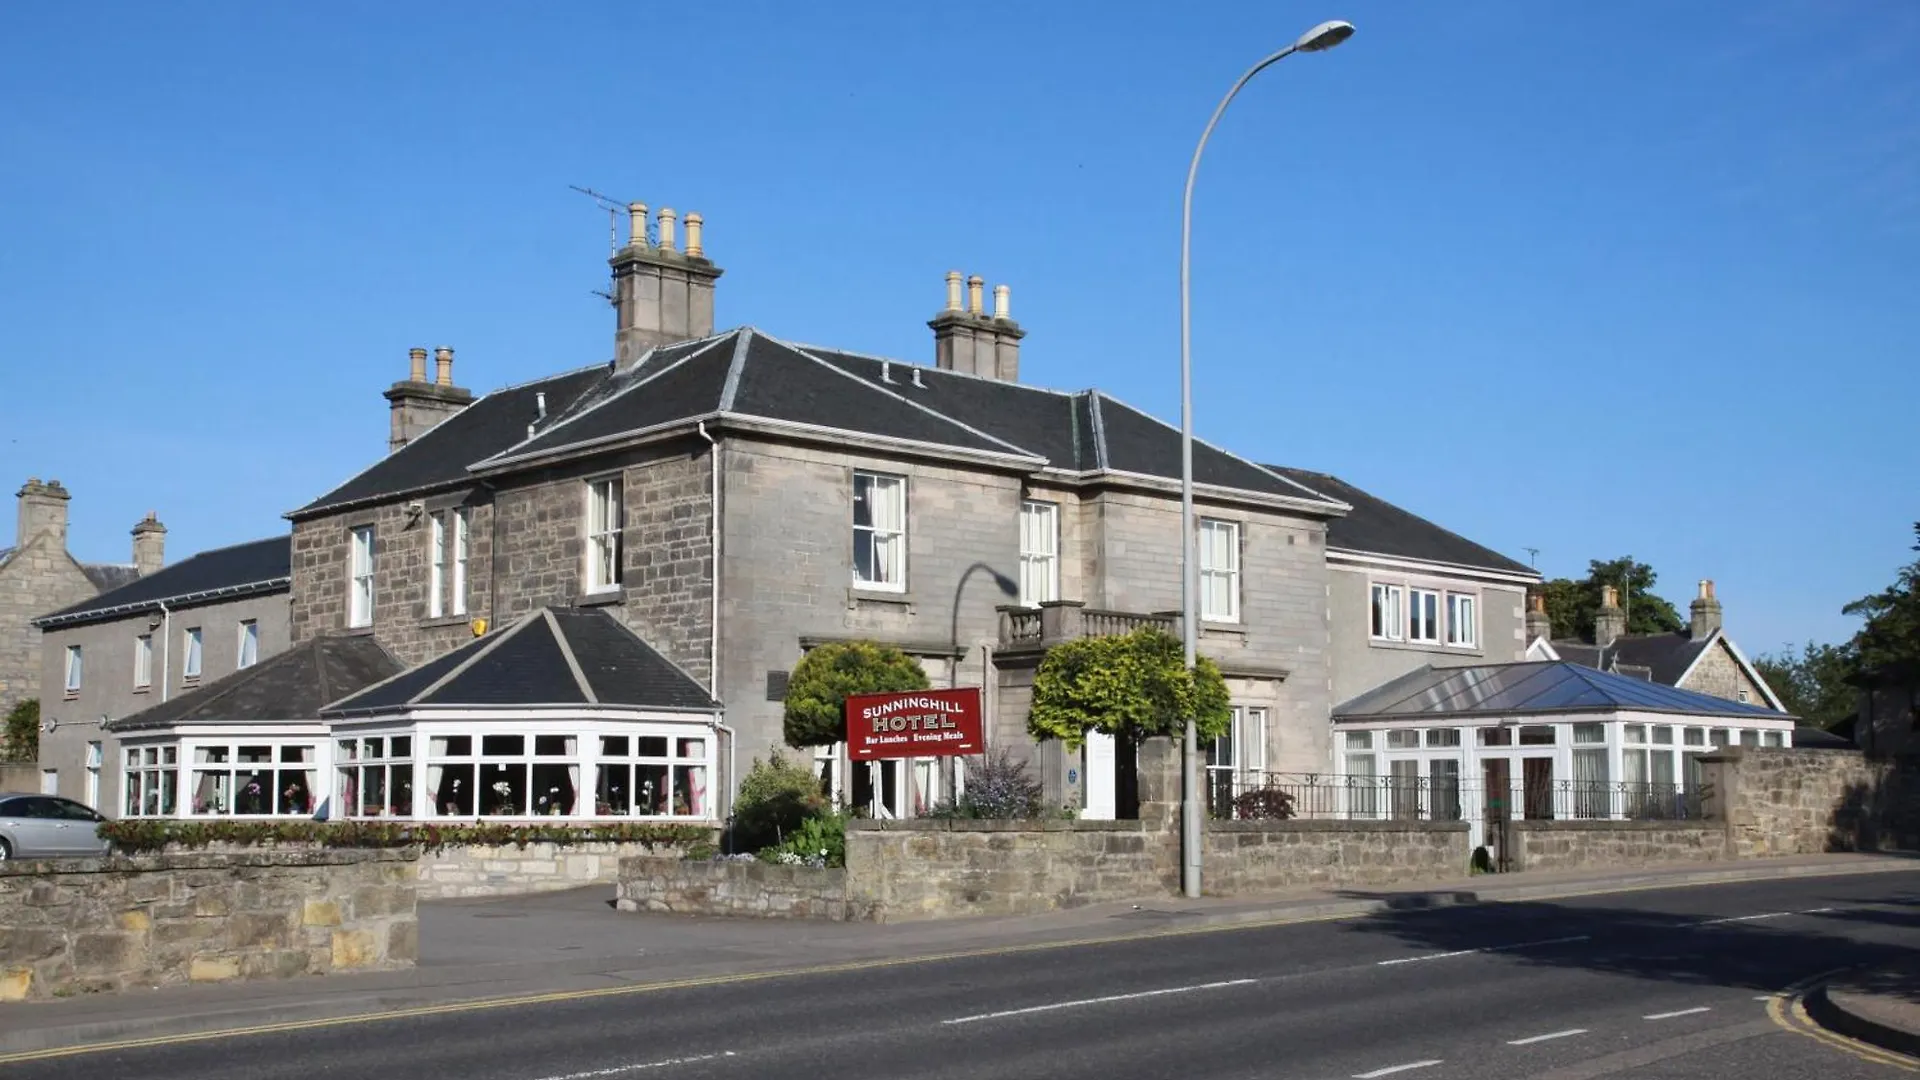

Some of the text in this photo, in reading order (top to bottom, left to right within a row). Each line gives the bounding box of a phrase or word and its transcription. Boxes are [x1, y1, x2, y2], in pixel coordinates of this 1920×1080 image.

[863, 697, 964, 719] SUNNINGHILL
[872, 713, 956, 732] HOTEL
[865, 731, 964, 745] Bar Lunches Evening Meals
